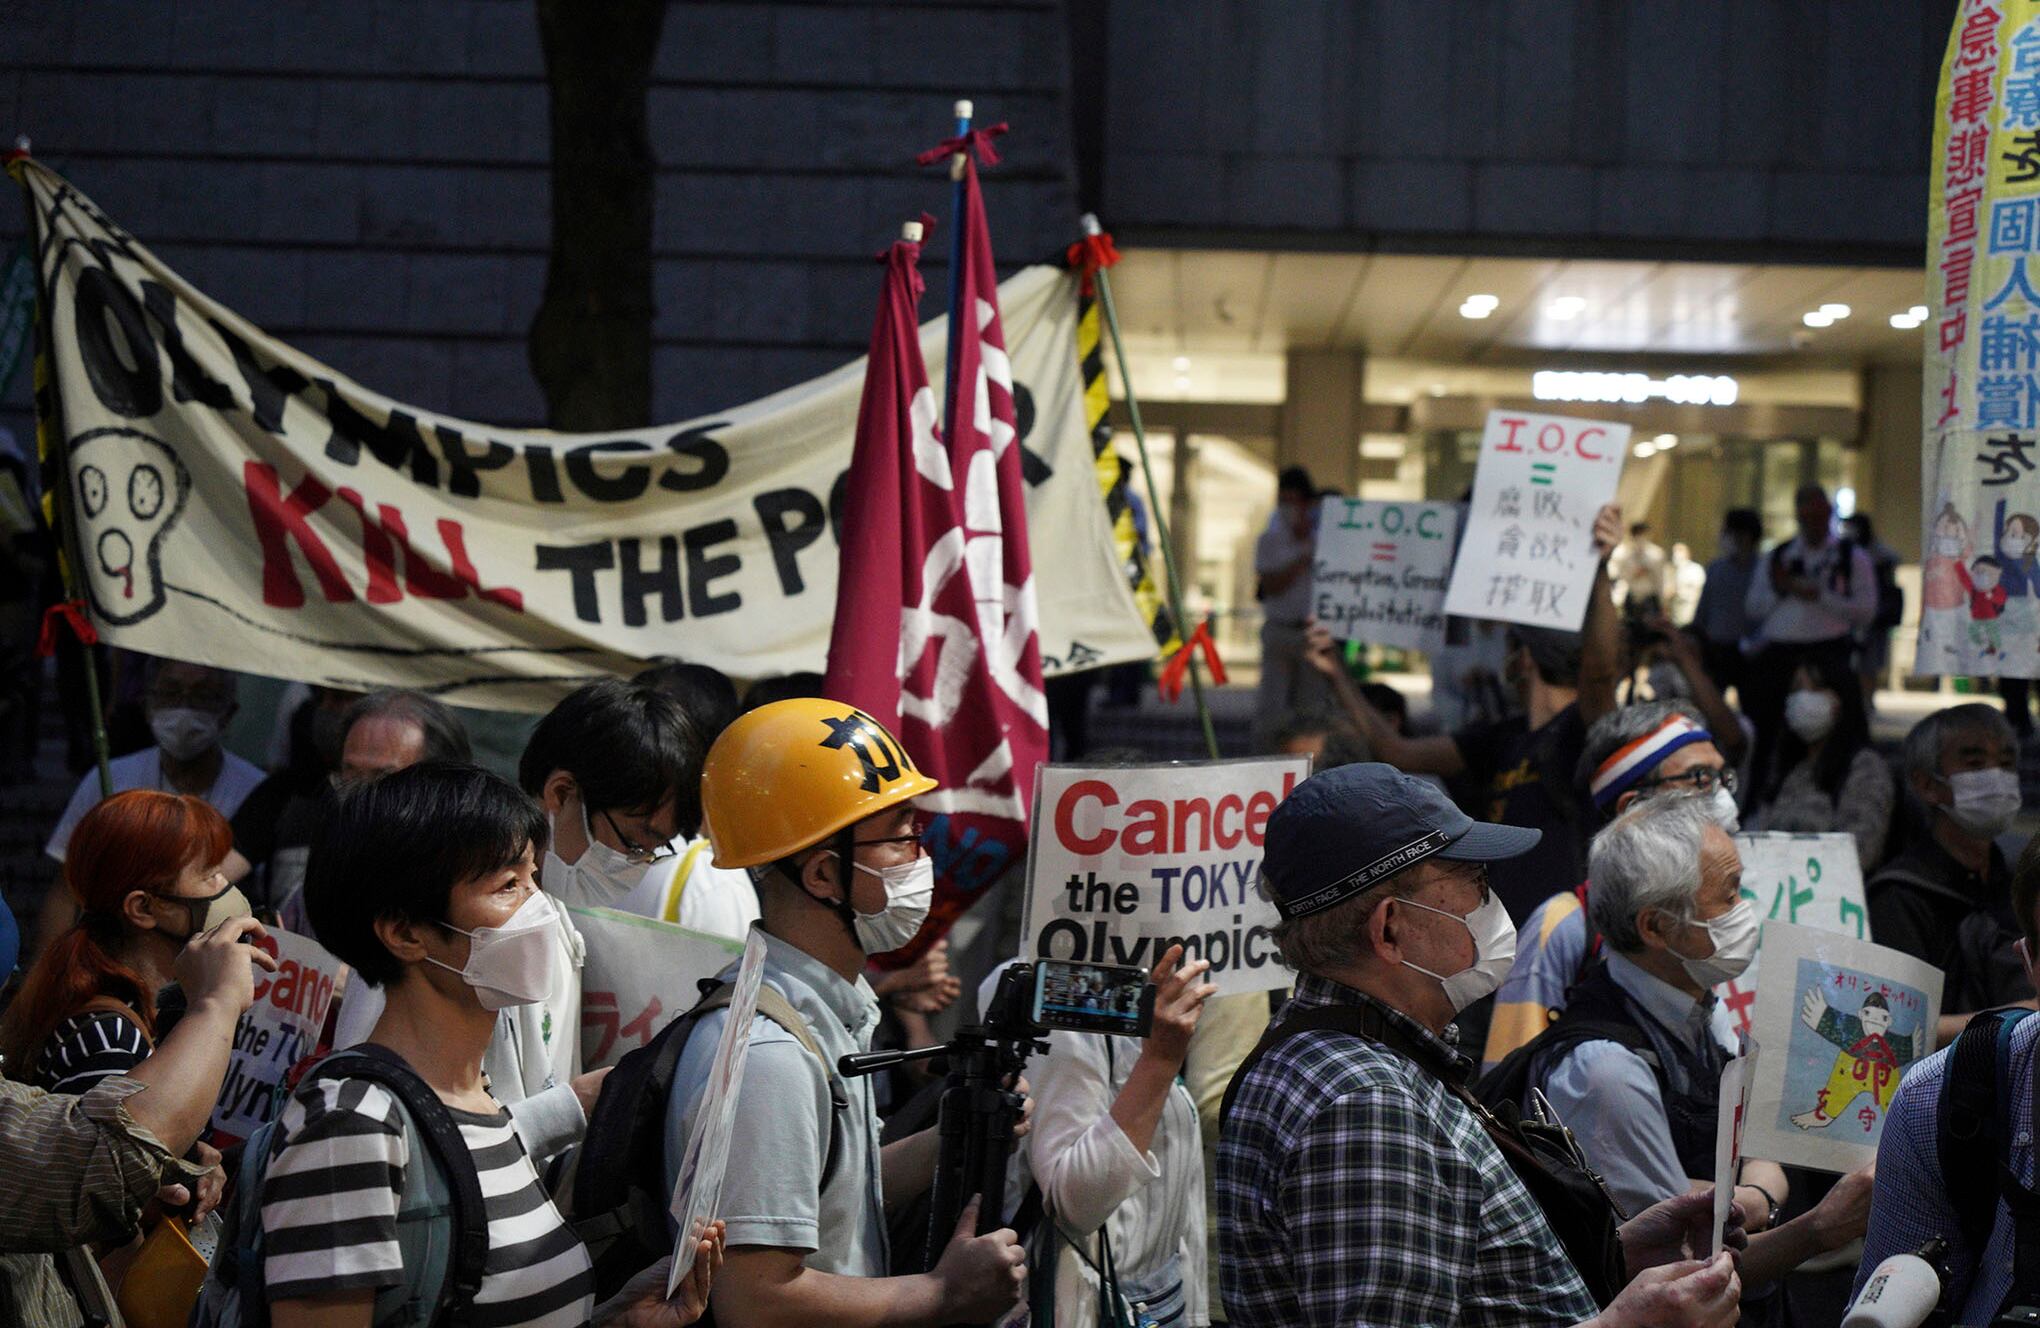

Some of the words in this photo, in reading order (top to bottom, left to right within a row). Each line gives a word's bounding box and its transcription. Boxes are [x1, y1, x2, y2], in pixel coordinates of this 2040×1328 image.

[74, 265, 732, 503] OLYMPICS
[1495, 418, 1615, 463] I.O.C.
[243, 459, 525, 613] KILL
[1337, 500, 1445, 540] I.O.C.
[535, 518, 742, 628] THE
[1066, 872, 1139, 914] the
[1152, 860, 1266, 913] TOKY
[1348, 872, 1369, 888] THE
[1369, 853, 1406, 877] NORTH
[1406, 841, 1432, 859] FACE
